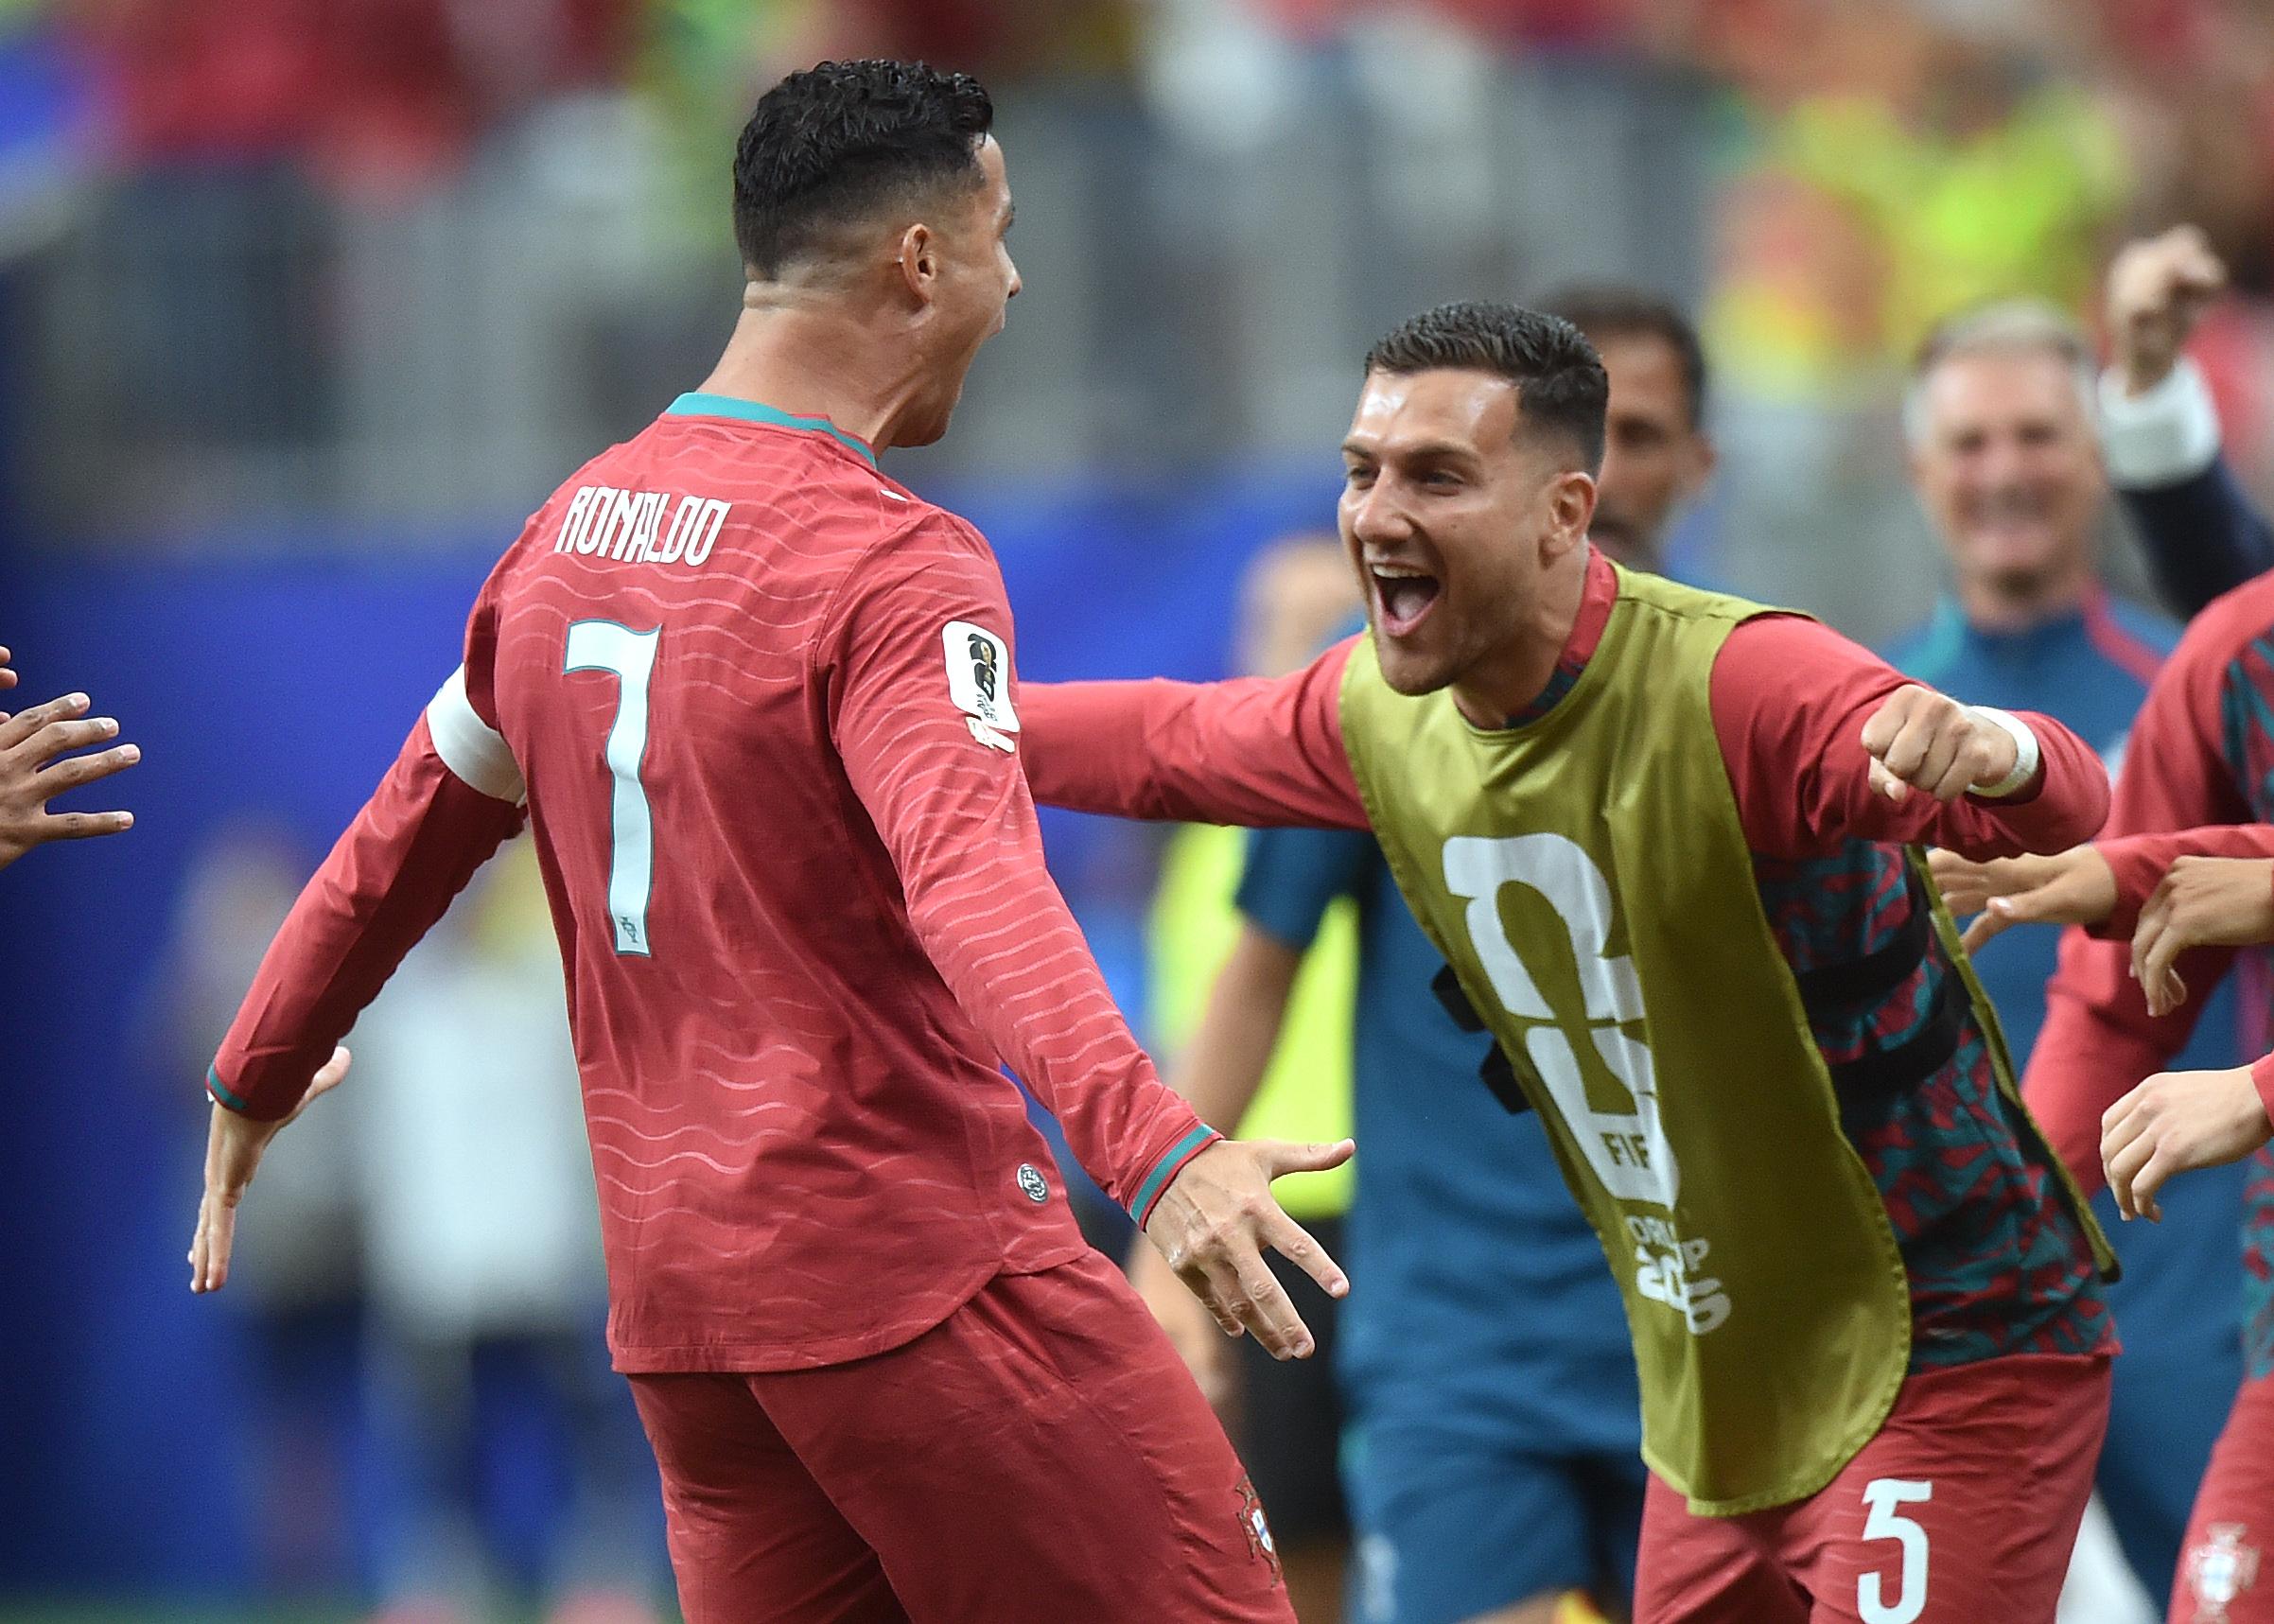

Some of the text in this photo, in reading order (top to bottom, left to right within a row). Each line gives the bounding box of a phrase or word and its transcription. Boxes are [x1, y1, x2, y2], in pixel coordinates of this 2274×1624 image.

[553, 485, 732, 567] RONALDO
[562, 618, 661, 956] 7
[1857, 1478, 1933, 1624] 5
